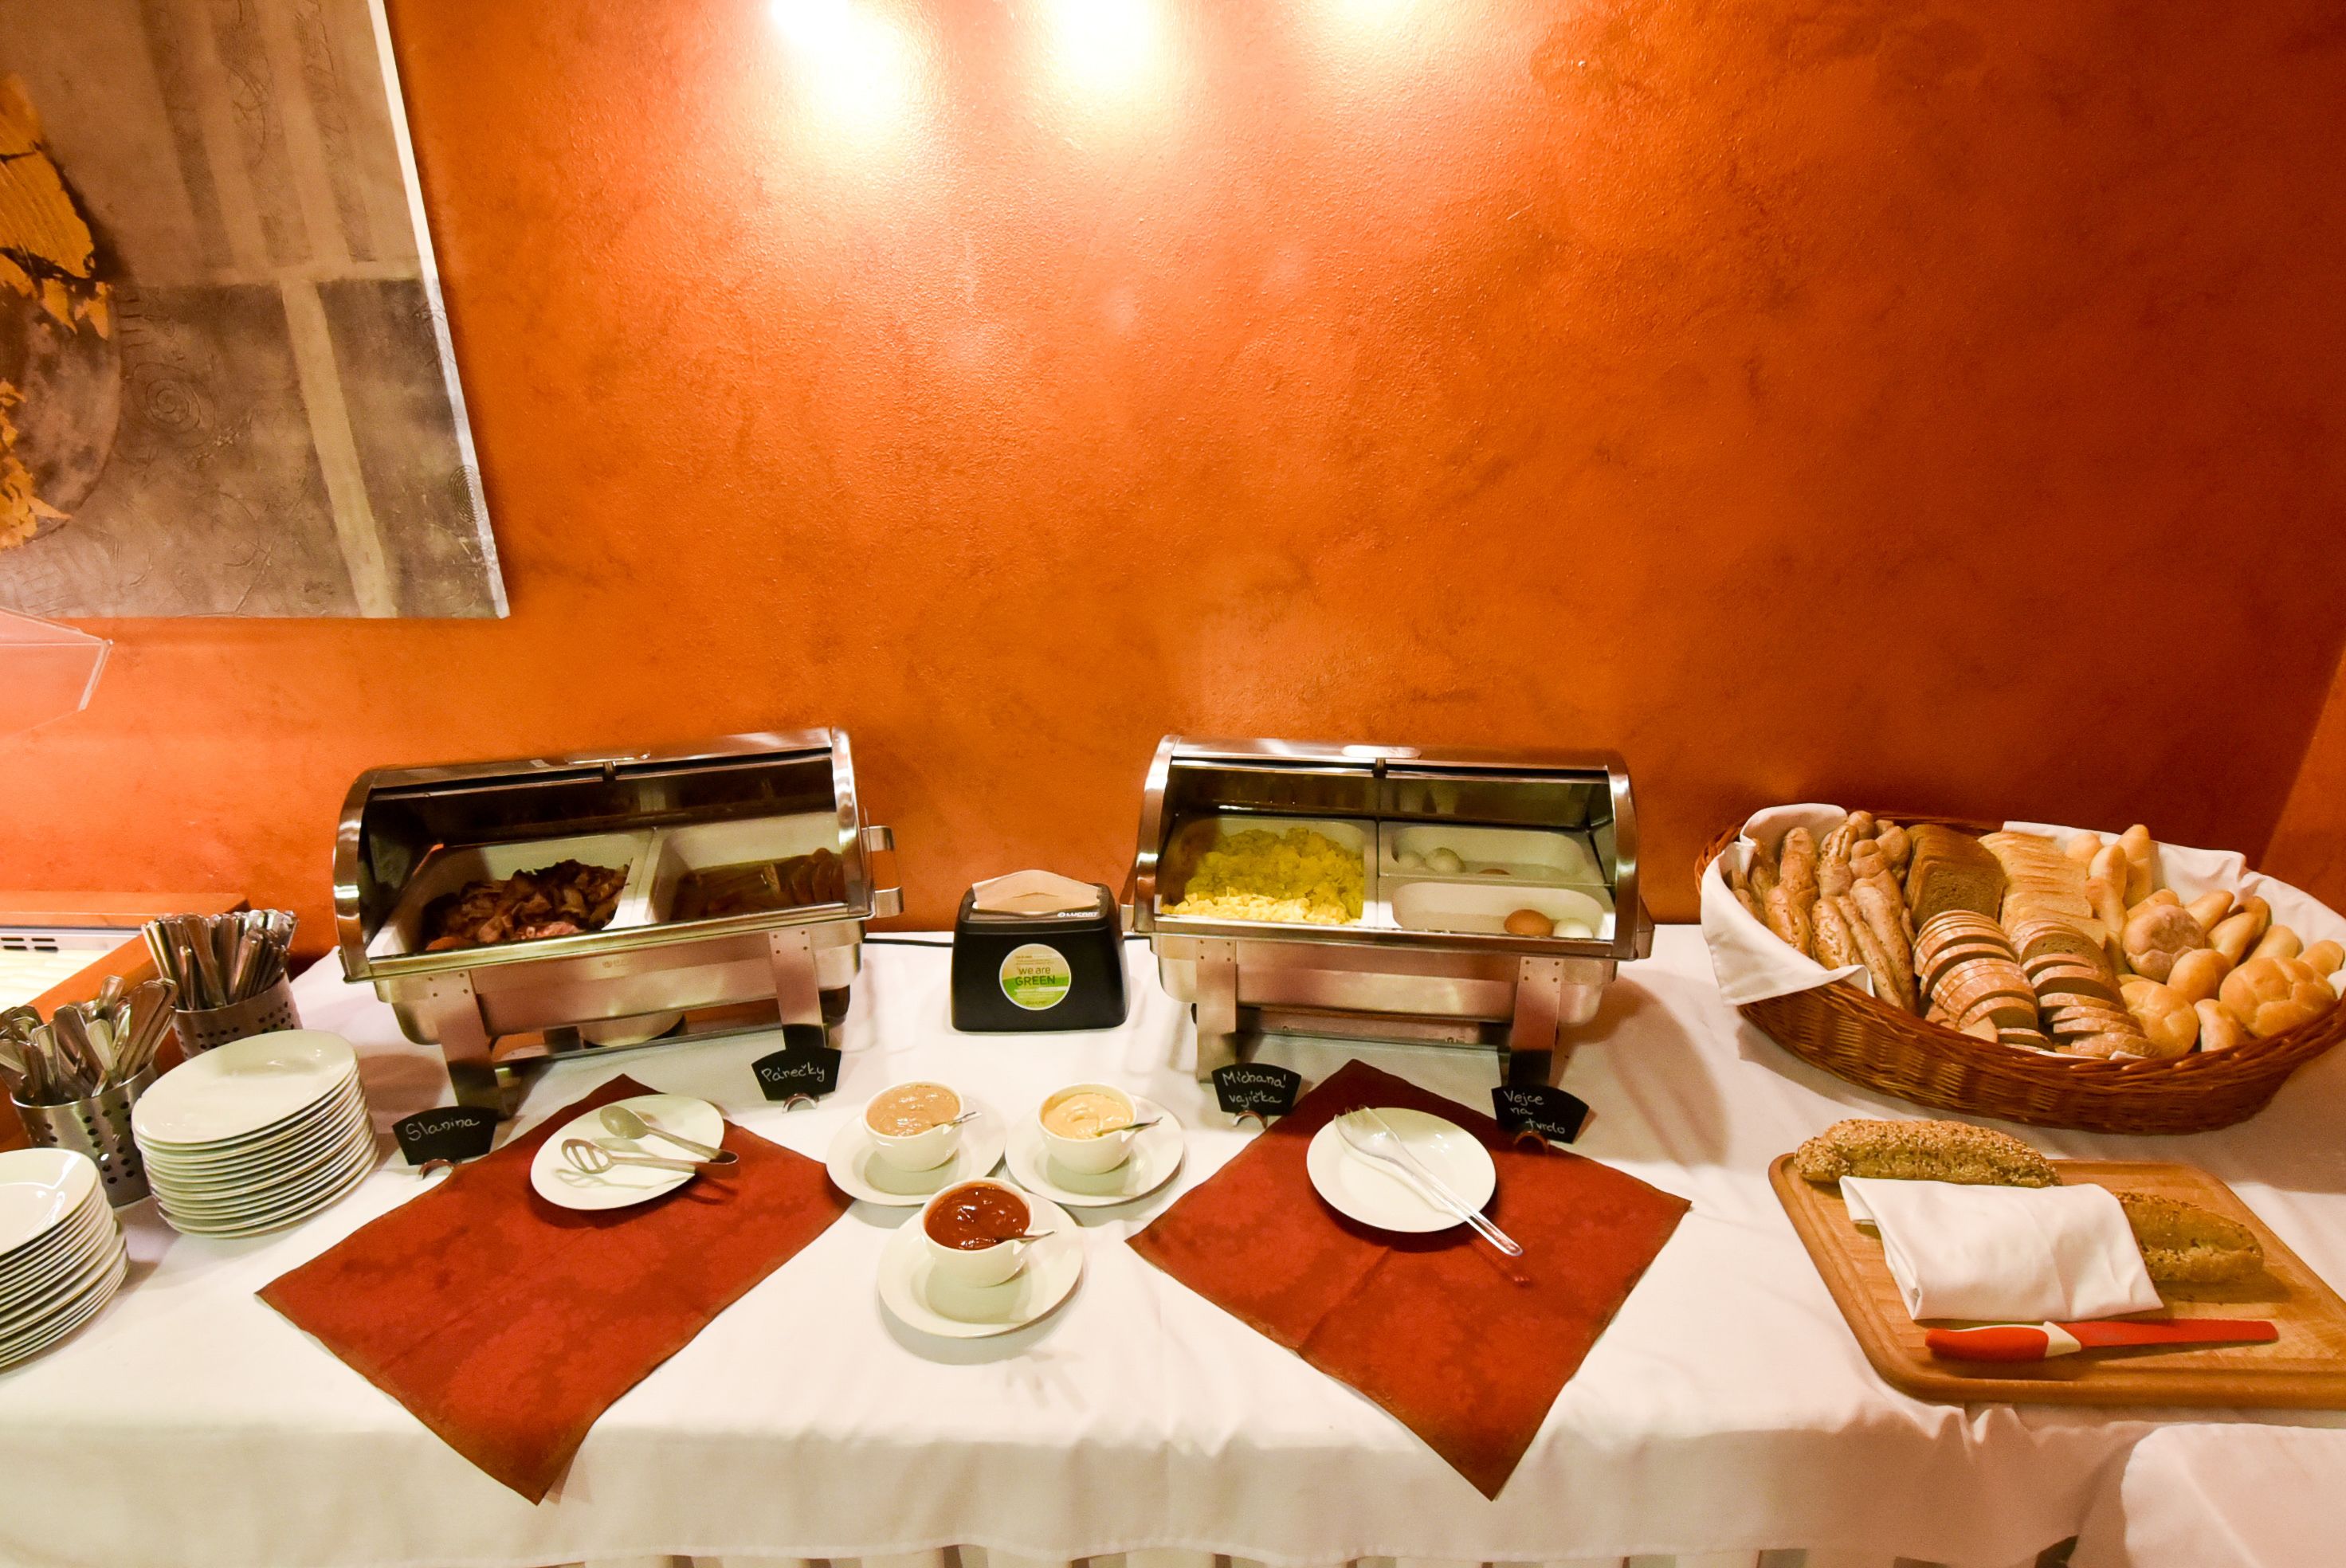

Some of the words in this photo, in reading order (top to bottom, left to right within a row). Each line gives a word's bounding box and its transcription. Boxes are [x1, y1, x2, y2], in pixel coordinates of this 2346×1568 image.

[1014, 975, 1056, 986] GREEN
[761, 1062, 825, 1082] Párečky
[1503, 1090, 1544, 1106] Vejce
[1510, 1107, 1533, 1115] na
[405, 1118, 480, 1141] Slanina
[1525, 1118, 1565, 1134] tvrdo
